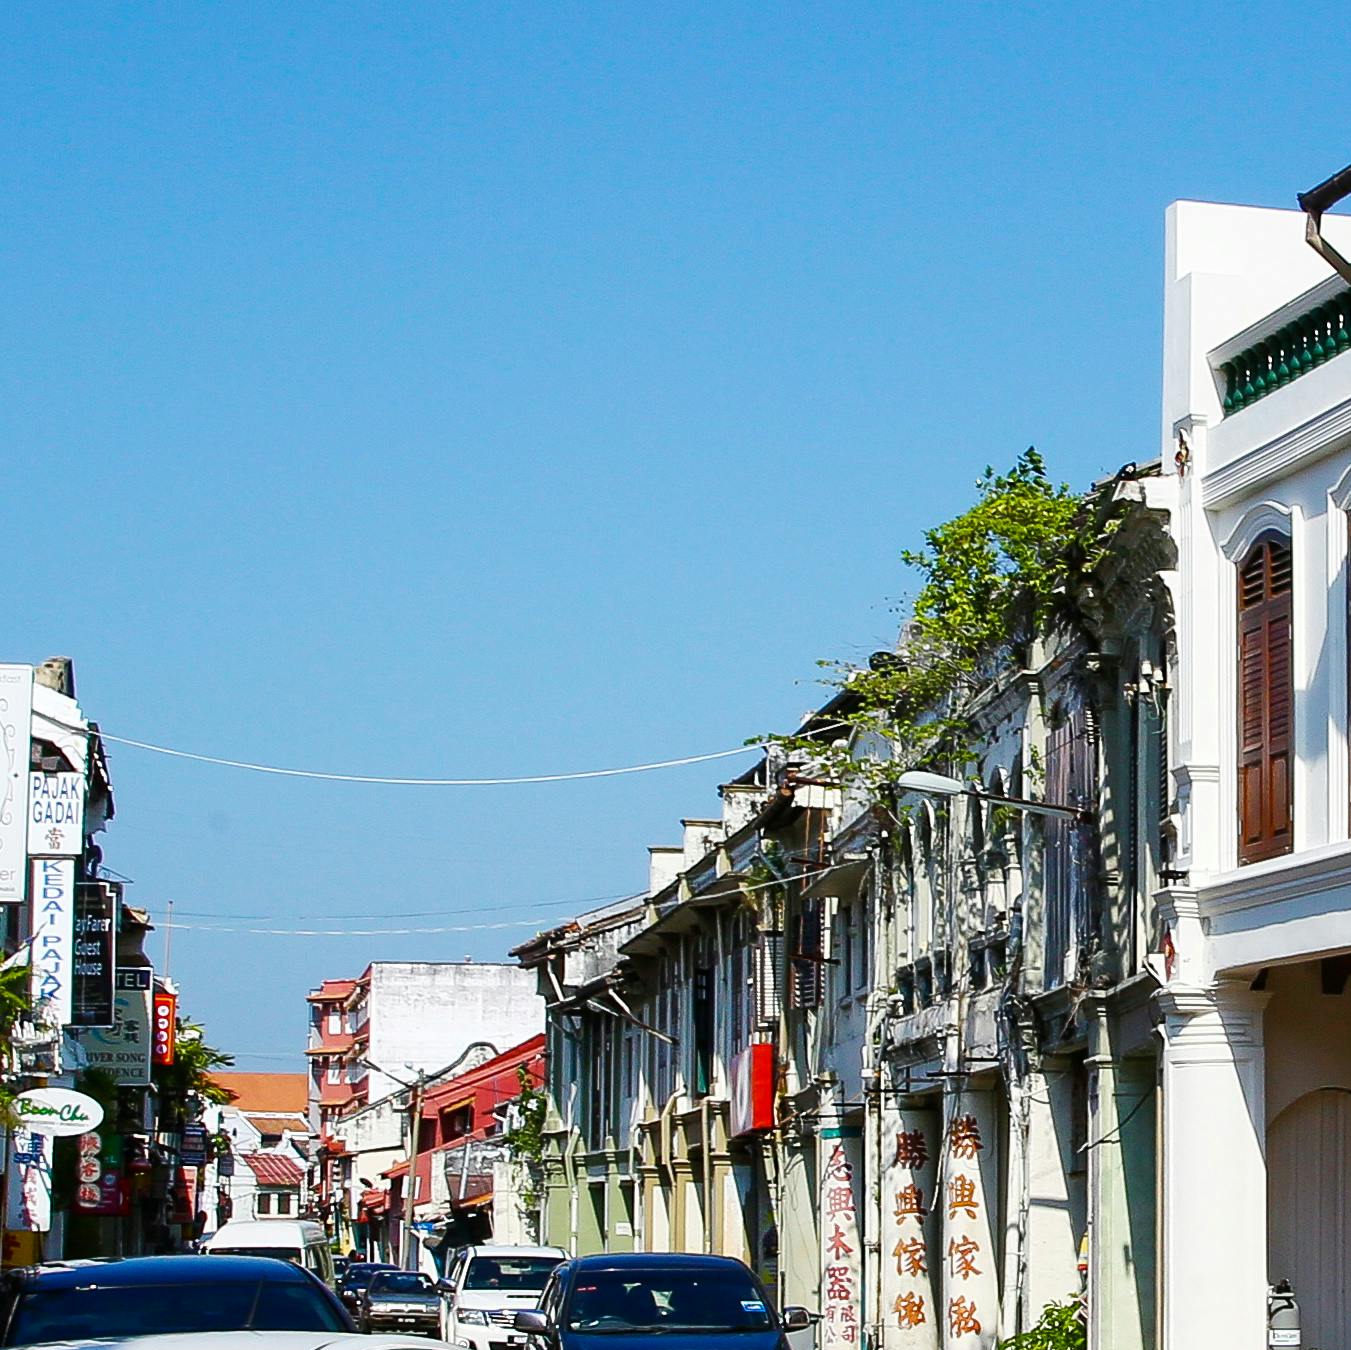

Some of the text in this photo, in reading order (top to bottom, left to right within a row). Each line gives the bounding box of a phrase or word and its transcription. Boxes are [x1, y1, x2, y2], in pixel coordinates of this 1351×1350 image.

[33, 776, 80, 800] PAJAK
[32, 801, 80, 825] GADAI
[42, 860, 64, 925] KEDAI
[86, 1052, 146, 1063] IVER SONG
